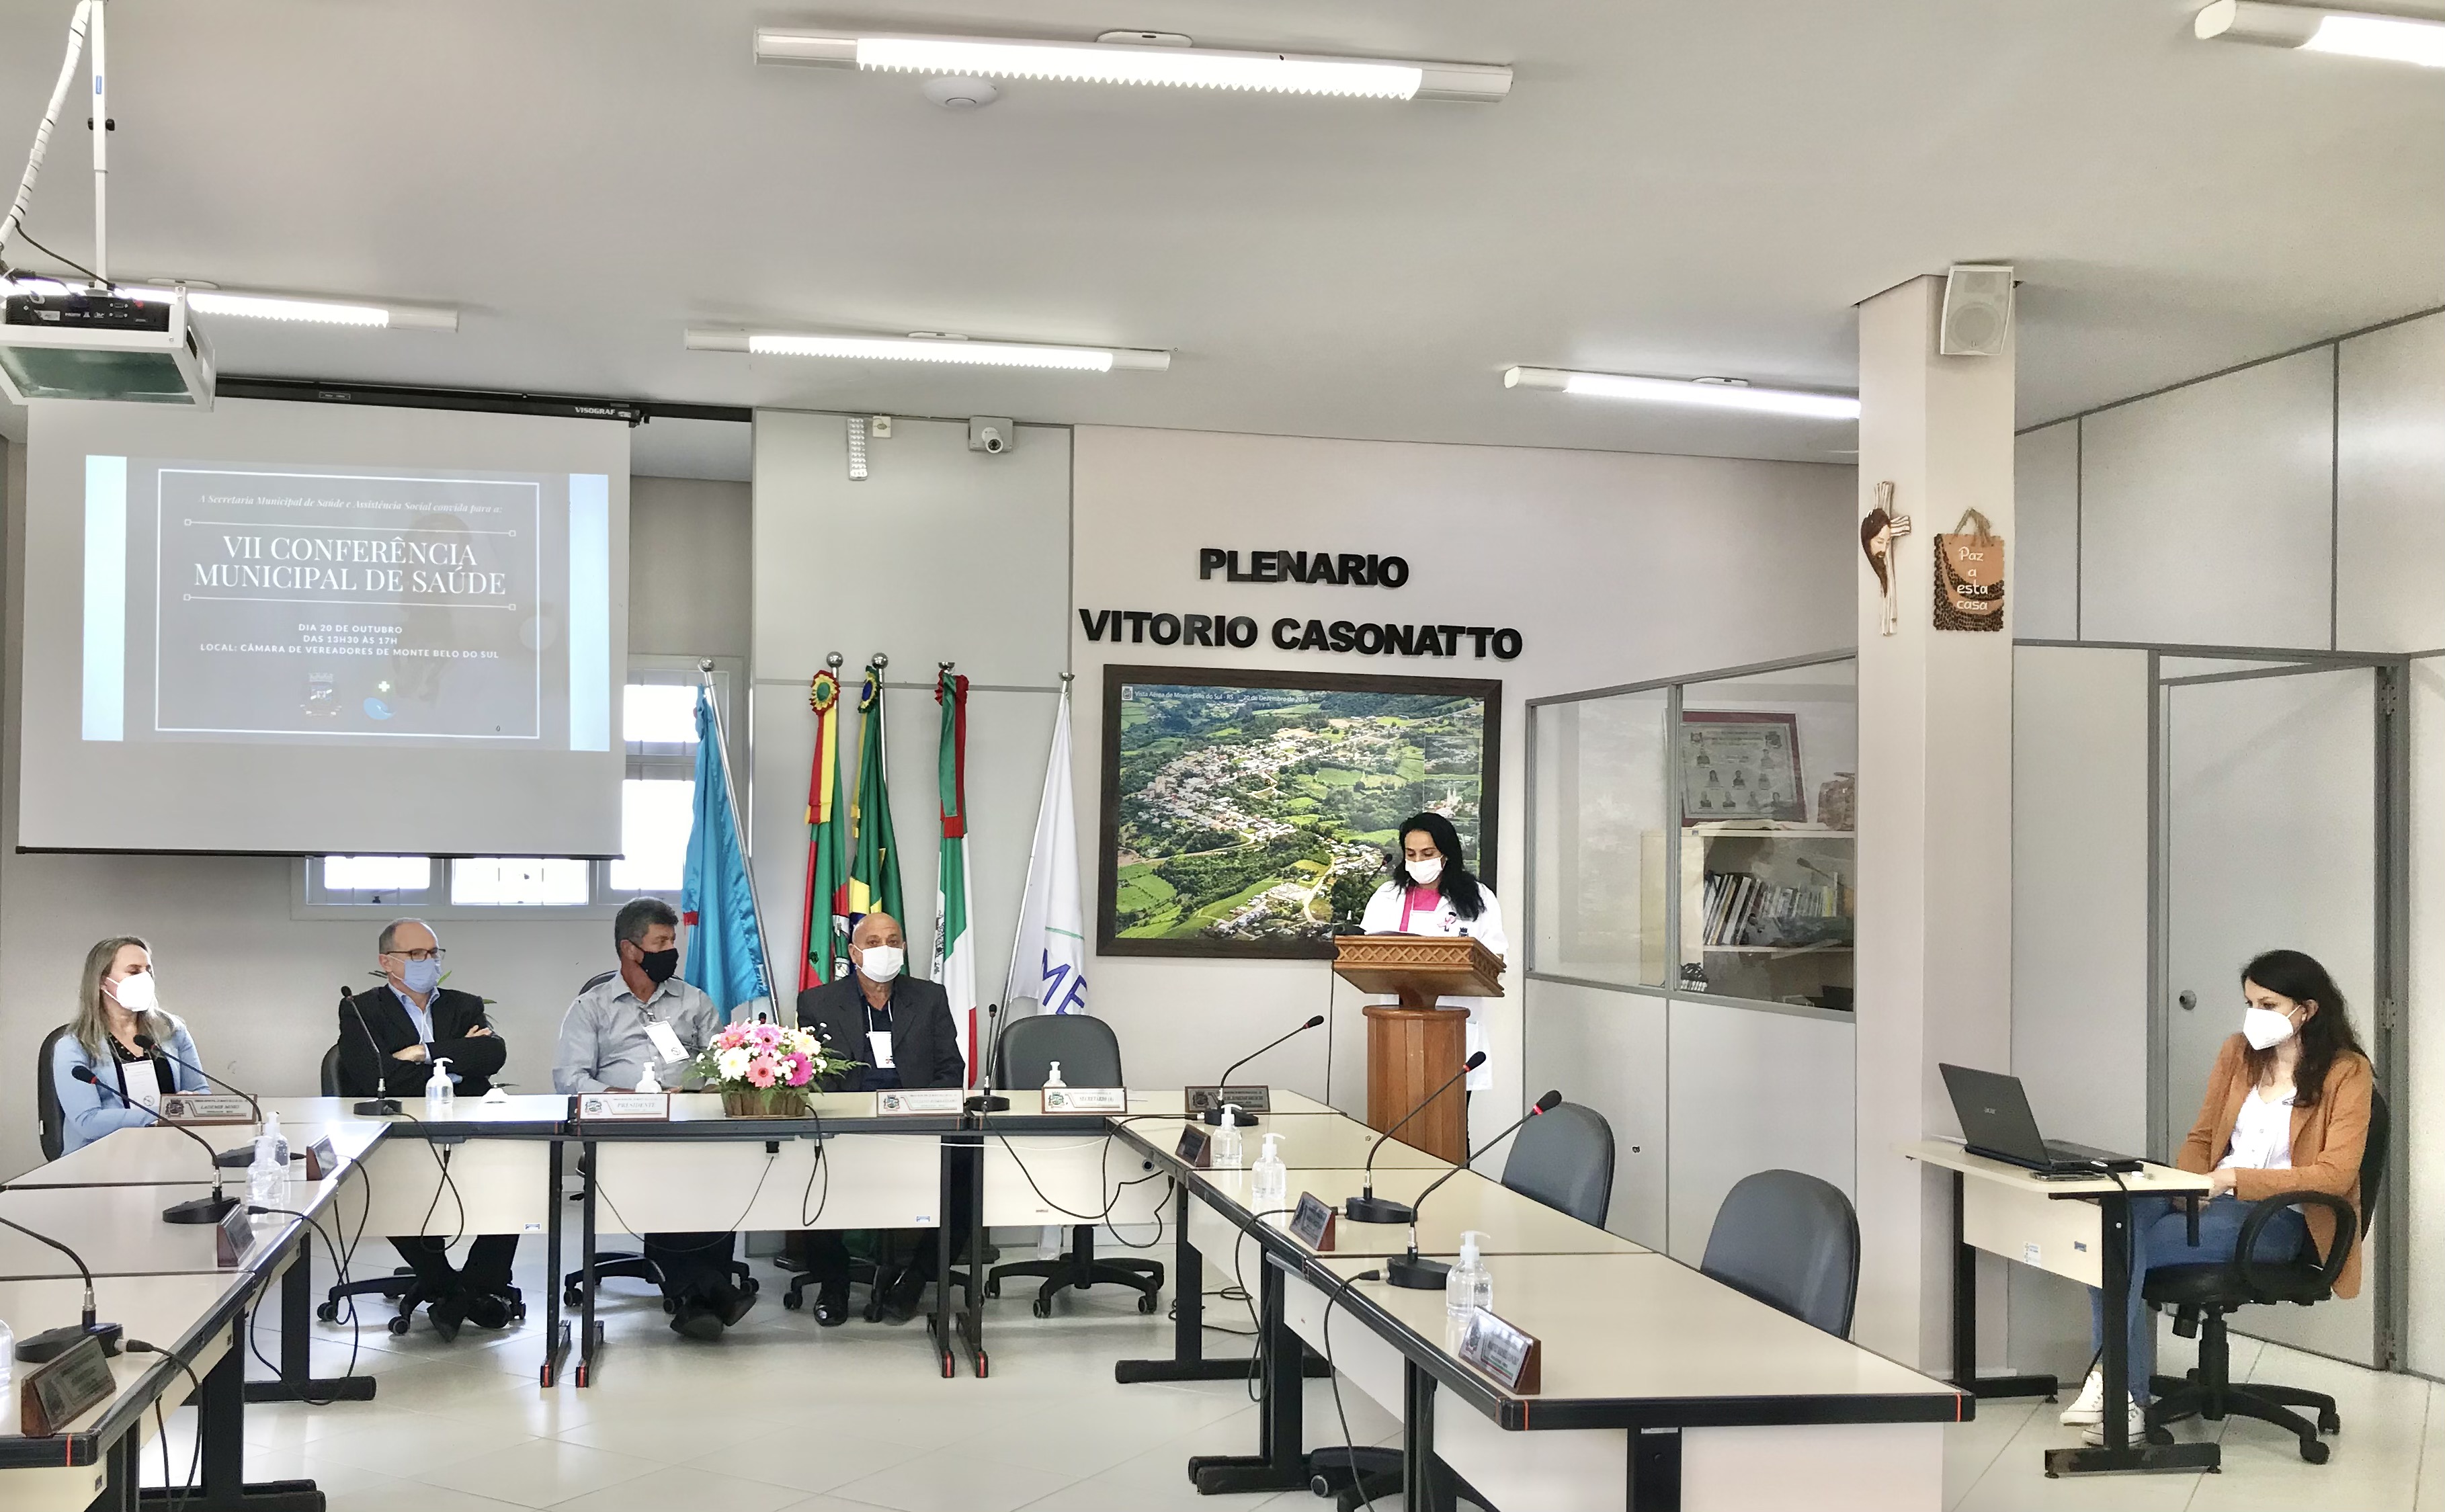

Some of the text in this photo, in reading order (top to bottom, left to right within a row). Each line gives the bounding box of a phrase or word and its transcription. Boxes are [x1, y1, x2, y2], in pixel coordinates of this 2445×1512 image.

[575, 407, 616, 415] VISOGRAF
[199, 495, 206, 503] A
[208, 495, 254, 505] Secretaria
[257, 496, 303, 507] Municipal
[304, 497, 314, 507] de
[317, 498, 345, 508] Saúde
[353, 500, 402, 510] Assistência
[405, 501, 431, 511] Social
[433, 503, 468, 512] convida
[470, 505, 491, 514] para
[223, 536, 479, 566] VII CONFERÊNCIA
[1958, 546, 1984, 562] Paz
[1200, 548, 1409, 588] PLENARIO
[1967, 568, 1977, 577] a
[194, 563, 506, 595] MUNICIPAL DE SAÚDE
[1956, 579, 1989, 595] esta
[1956, 599, 1989, 611] casa
[298, 624, 403, 634] DIA 20 DE OUTUBRO
[1079, 608, 1523, 660] VITORIO CASONATTO
[303, 634, 398, 645] DAS 13H30 ÀS 17H
[200, 642, 499, 659] LOCAL: CÂMARA DE VEREADORES DE MONTE BELO DO SUL
